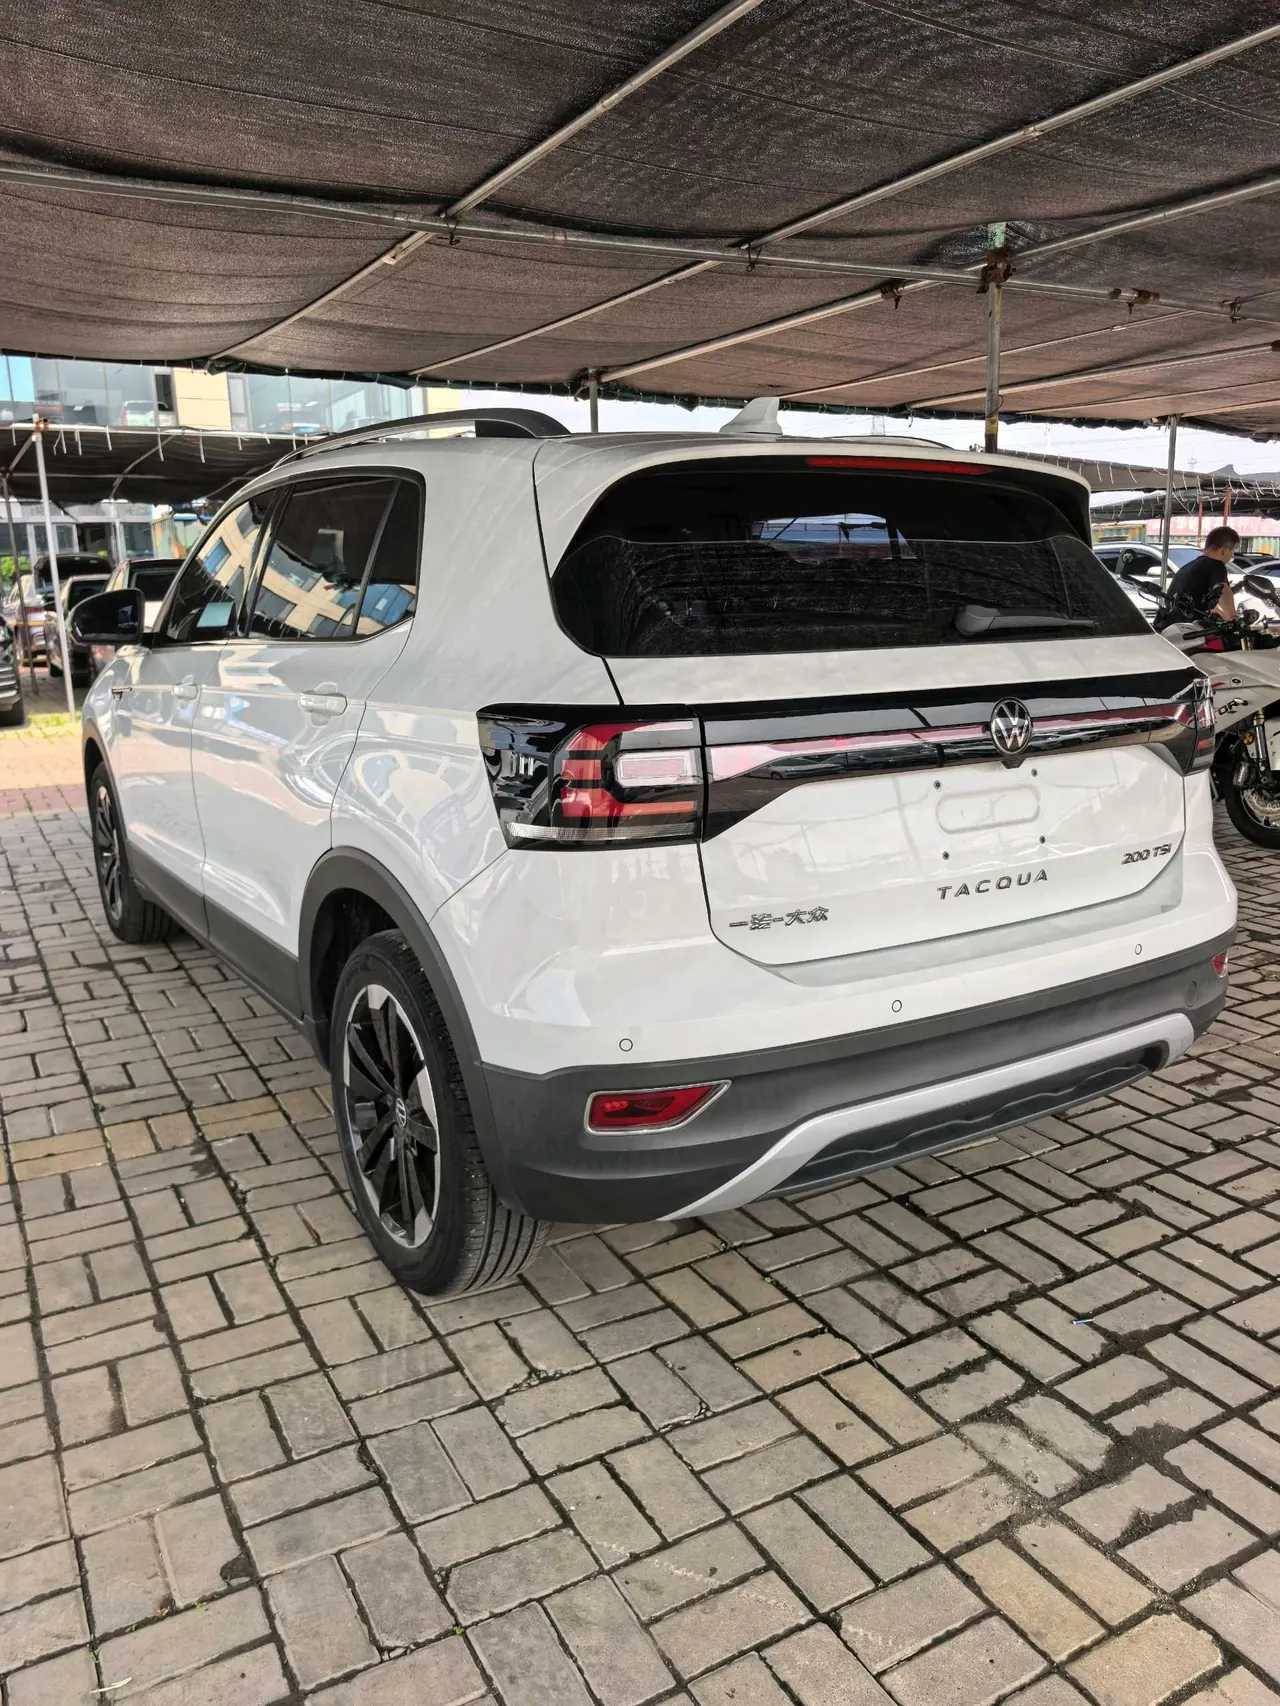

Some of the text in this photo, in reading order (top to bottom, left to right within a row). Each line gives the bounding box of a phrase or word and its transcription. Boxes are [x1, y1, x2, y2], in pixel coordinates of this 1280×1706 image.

[1121, 843, 1173, 865] 200 TSI
[936, 868, 1048, 900] TACQUA
